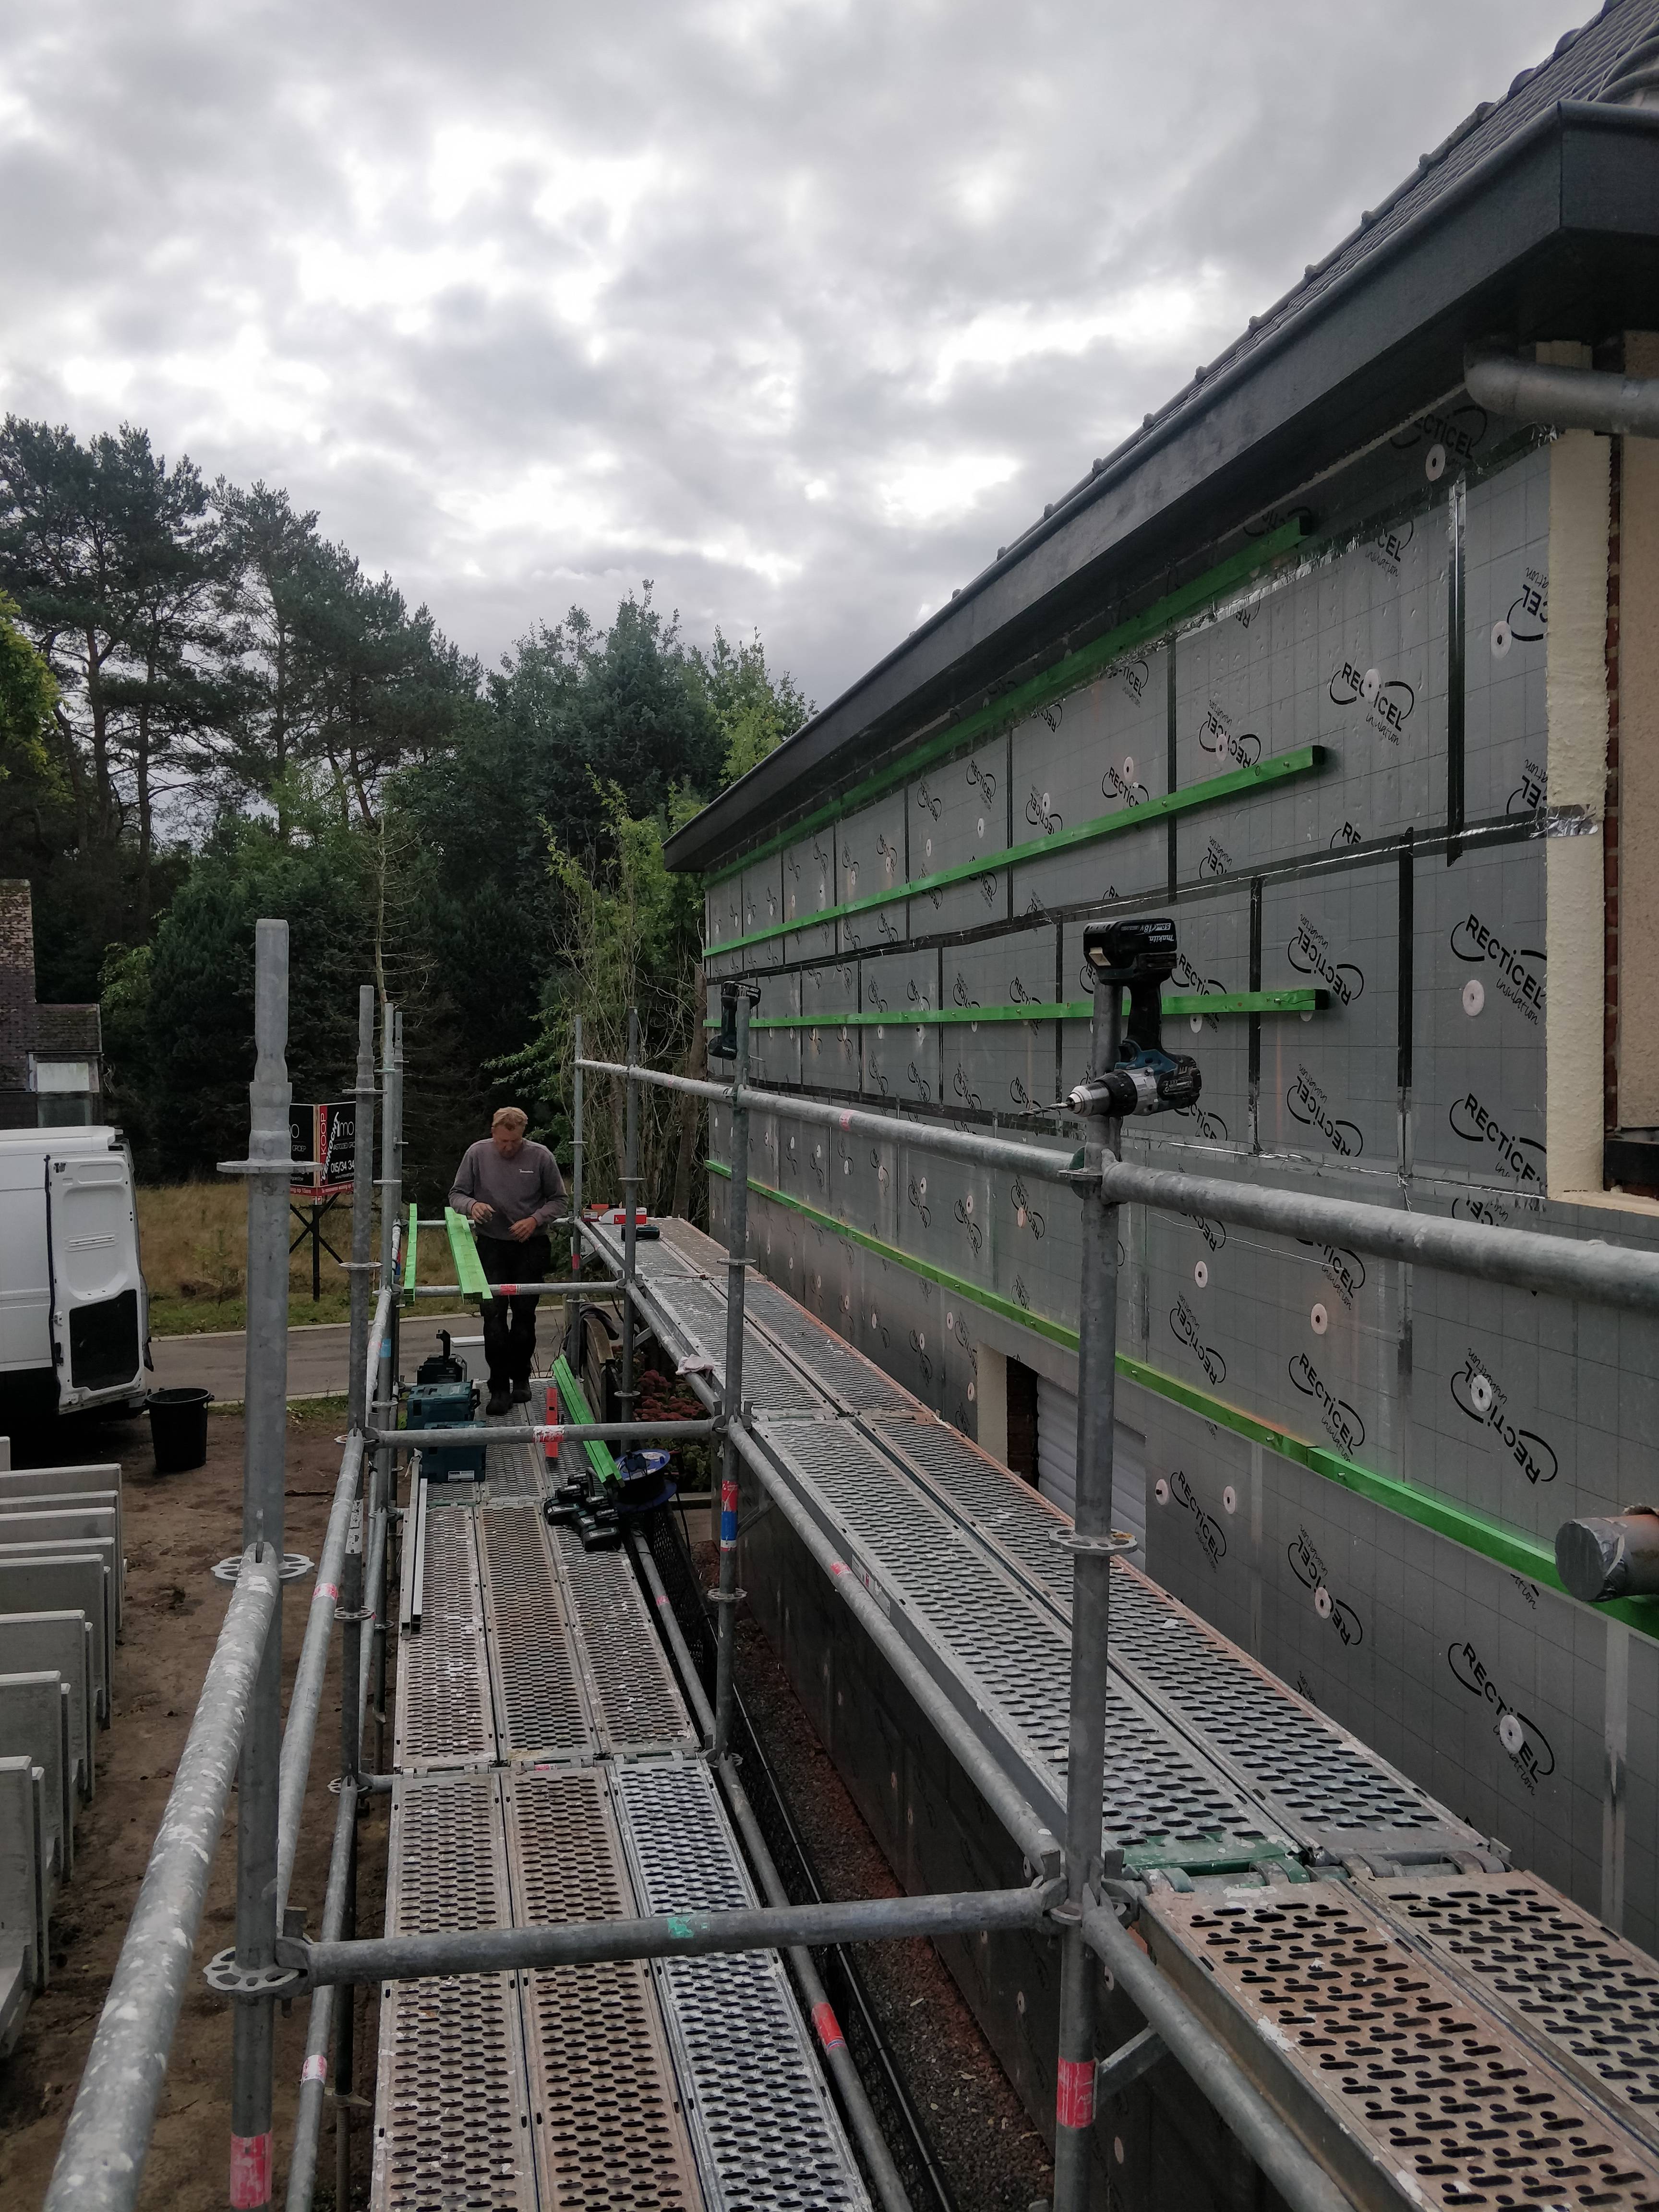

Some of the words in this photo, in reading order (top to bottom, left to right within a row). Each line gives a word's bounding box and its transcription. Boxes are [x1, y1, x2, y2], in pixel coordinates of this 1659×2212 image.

[1342, 662, 1402, 732] RECICEL
[971, 760, 992, 804] RECTICEL
[1030, 793, 1055, 835] ECTICEL
[1108, 767, 1140, 808] RECTIC
[1298, 926, 1351, 1006] RECTICEL
[1466, 914, 1541, 1010] RECTICEL
[1496, 976, 1539, 1025] insulation
[957, 1068, 975, 1110] ECTICEL
[1297, 1075, 1351, 1156] RECTICEL
[1464, 1093, 1540, 1181] RECTICE
[958, 1199, 978, 1254] RECTICEL
[1317, 1243, 1354, 1299] TICEL
[1177, 1300, 1218, 1385] RECTICEL
[1299, 1353, 1353, 1455] RECTICEL
[1465, 1360, 1540, 1485] RECTIL
[1178, 1470, 1218, 1564] RECTICEL
[1463, 1642, 1539, 1783] RECTEL
